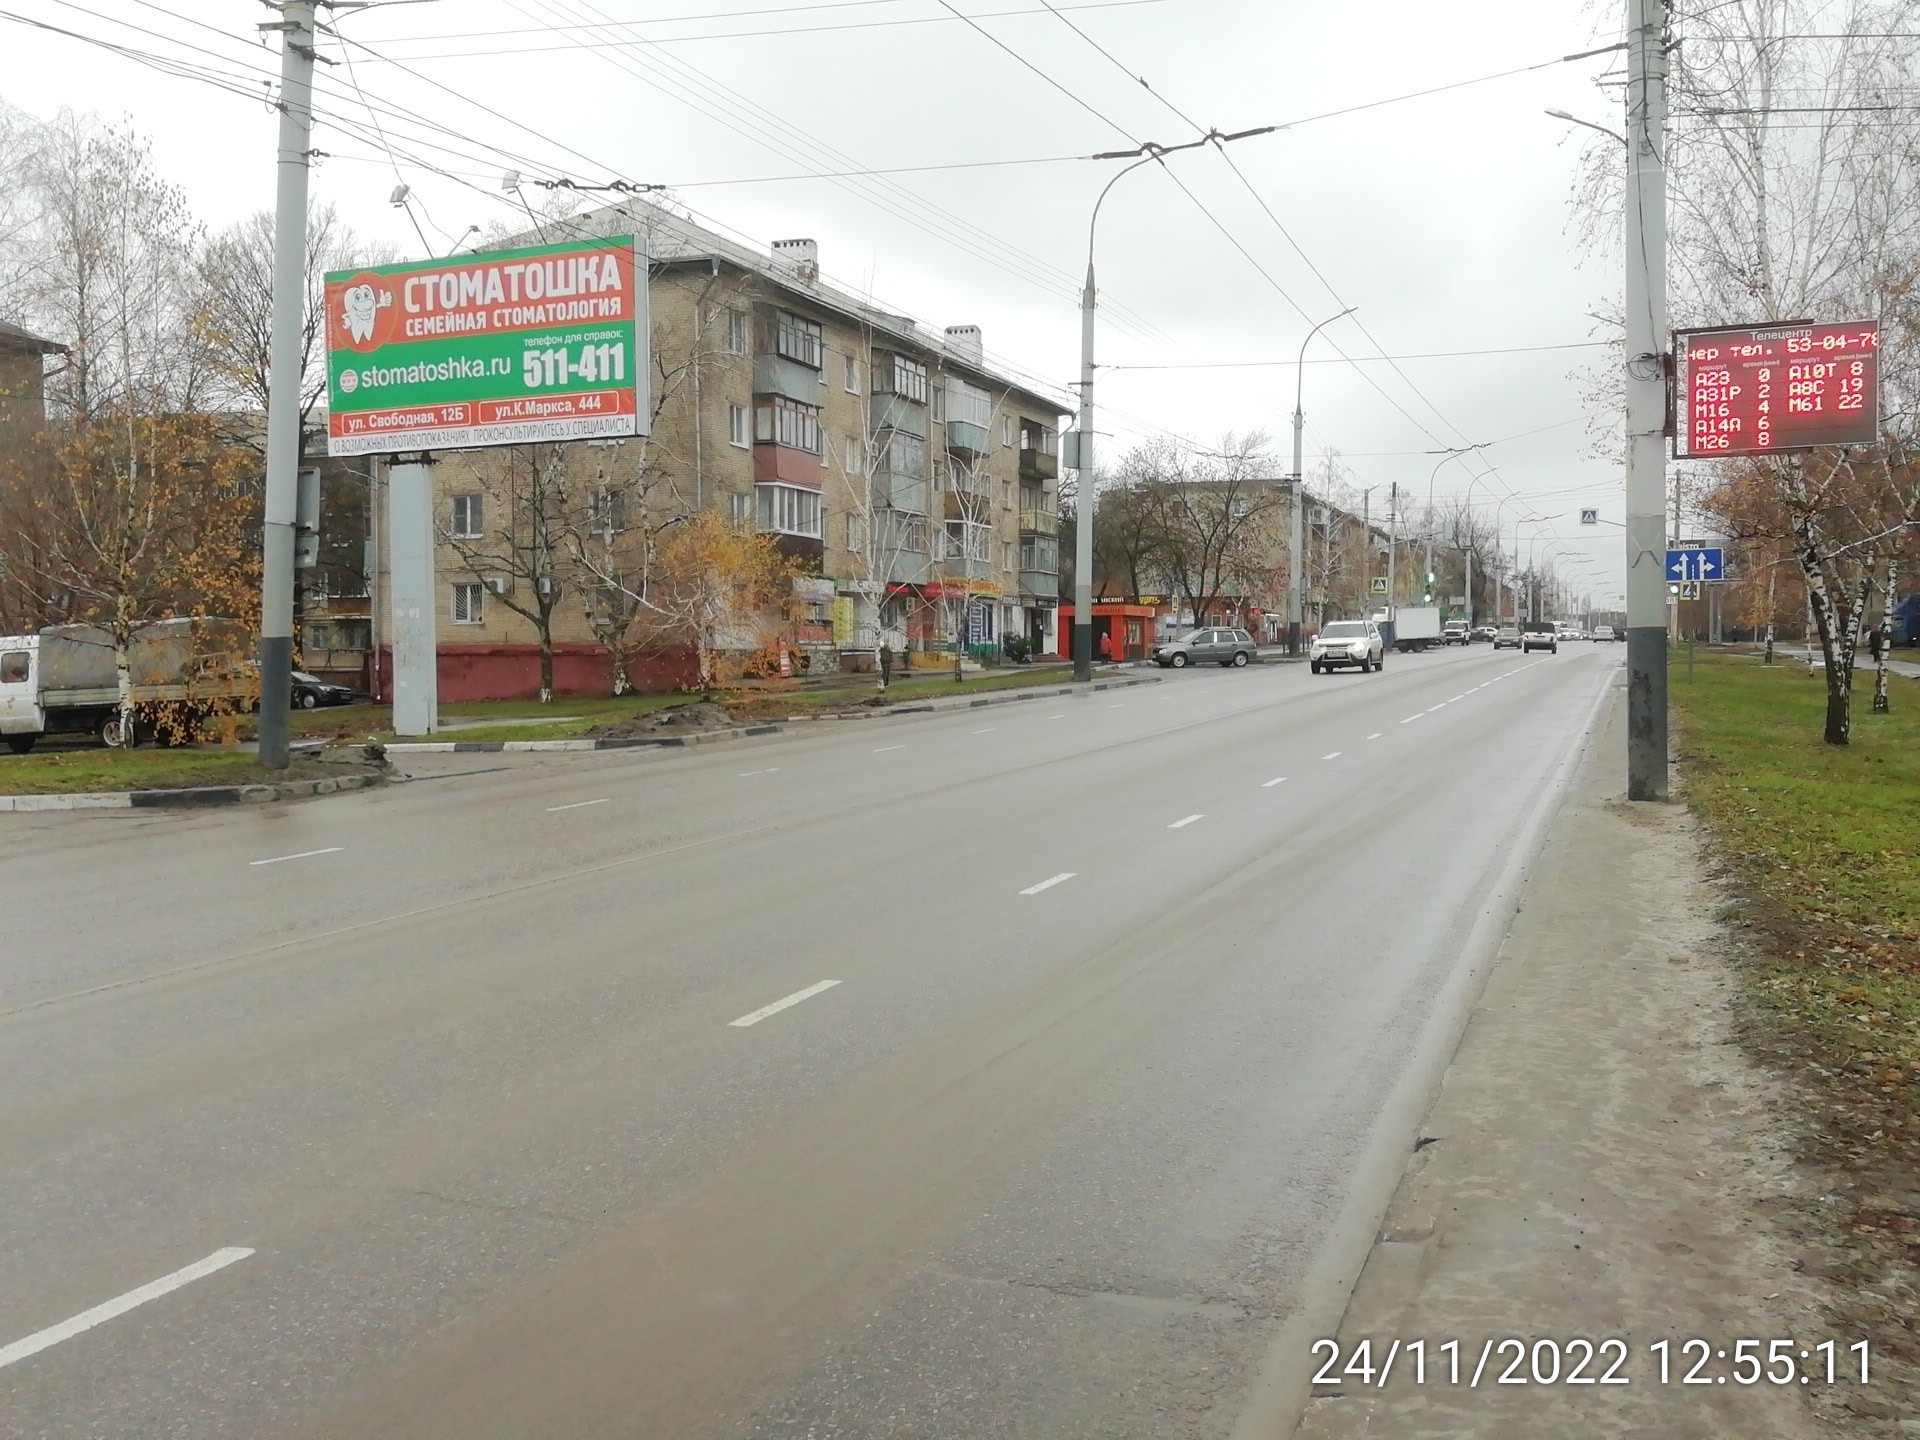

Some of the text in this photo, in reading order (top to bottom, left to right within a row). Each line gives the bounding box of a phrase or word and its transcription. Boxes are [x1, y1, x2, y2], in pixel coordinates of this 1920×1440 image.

[404, 254, 622, 313] СТОМАТОШКА
[405, 297, 622, 337] СЕМЕЙНАЯ СТОМАТОЛОГИЯ
[523, 329, 624, 347] телефон для справок:
[1750, 329, 1813, 341] Телецентр
[361, 355, 511, 388] stomatoshka.ru
[523, 342, 624, 388] 511-411
[1789, 361, 1863, 380] А10Т 8
[1695, 368, 1771, 387] А23 0
[1789, 377, 1863, 396] А8С 19
[1695, 384, 1770, 402] А31Р 2
[495, 395, 601, 420] ул.К.Маркса, 444
[1695, 400, 1770, 418] М16 4
[1789, 394, 1863, 413] М61 22
[348, 407, 464, 432] ул. Свободная, 12Б
[1695, 416, 1770, 434] А14А 6
[341, 436, 388, 453] ВОЗМОЖНЫХ
[389, 429, 470, 449] ПРОТИВОПОКАЗАНИЯХ
[473, 421, 564, 442] ПРОКОНСУЛЬТИРУЙТЕСЬ
[573, 417, 631, 436] СПЕЦИАЛИСТА
[1695, 431, 1770, 450] М26 8
